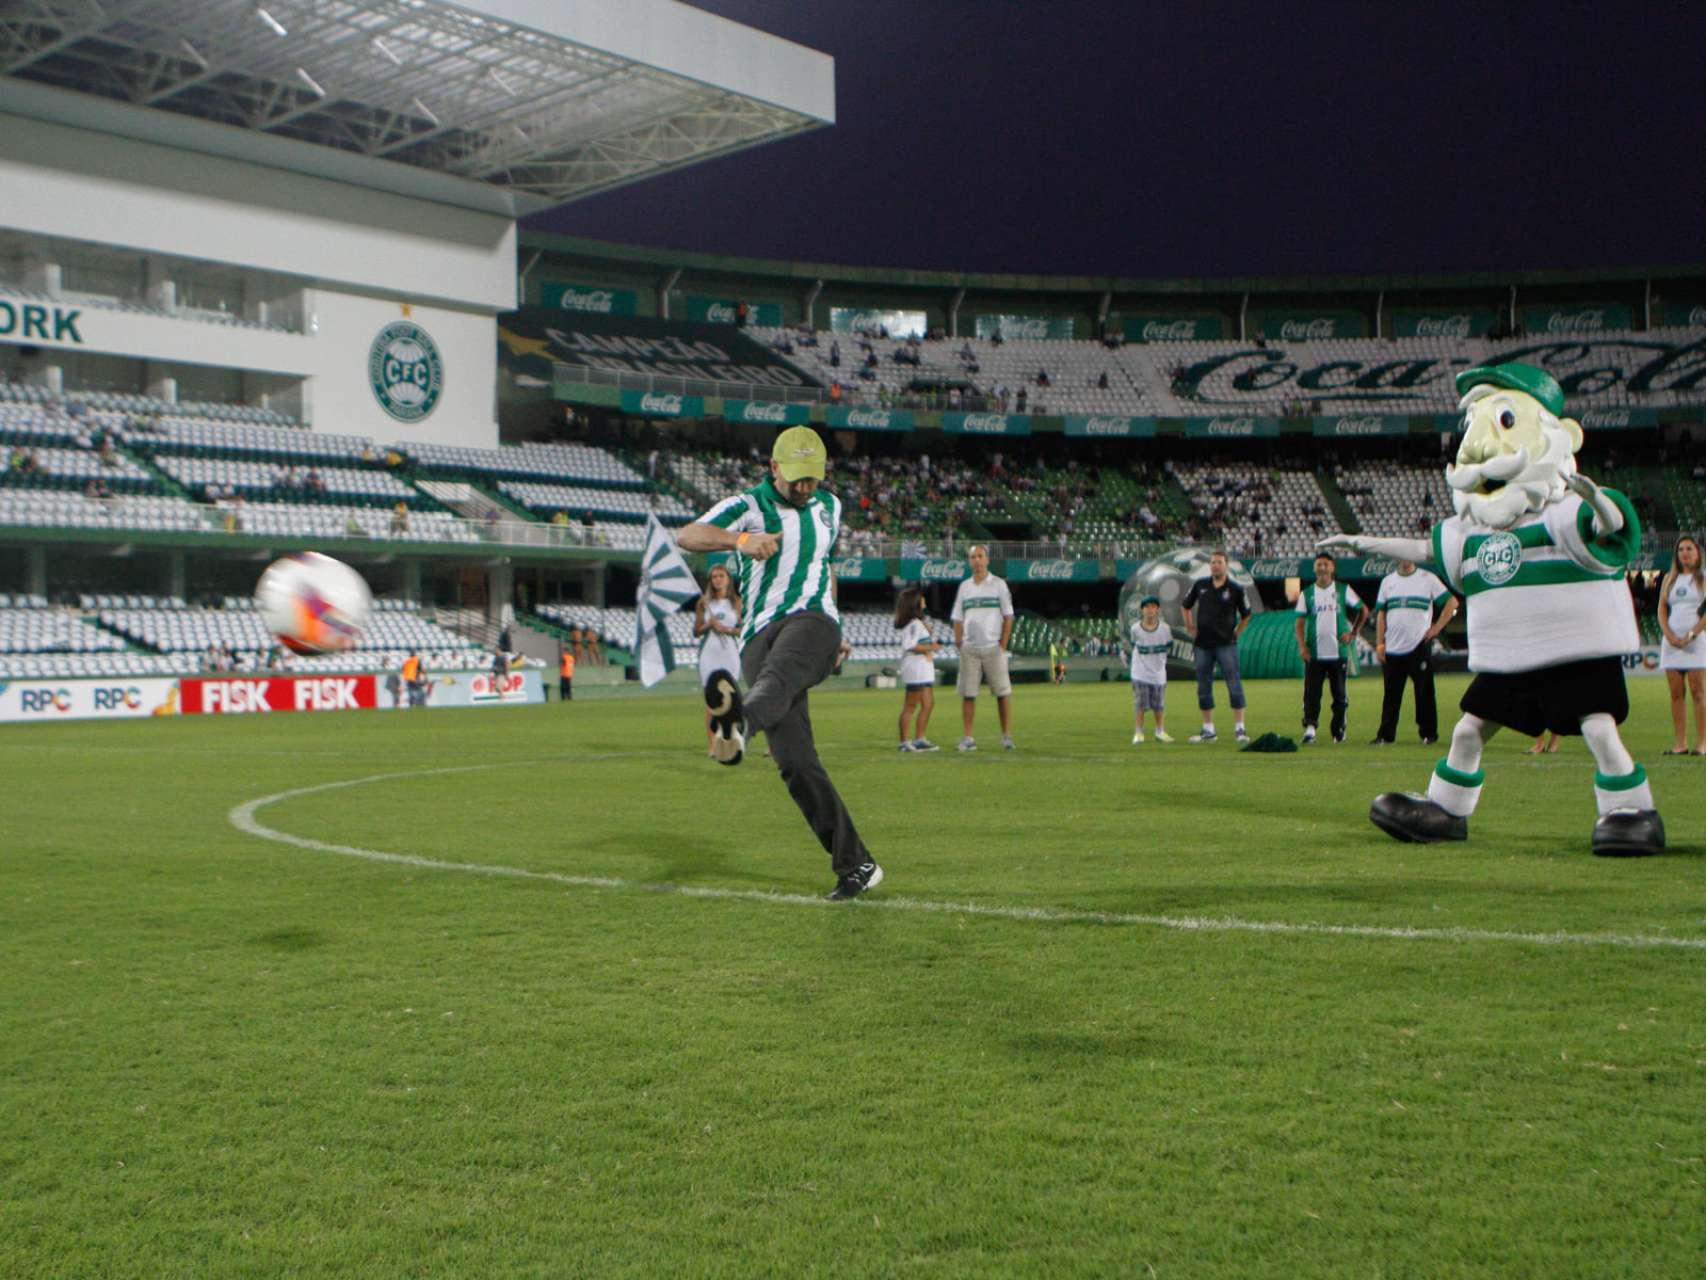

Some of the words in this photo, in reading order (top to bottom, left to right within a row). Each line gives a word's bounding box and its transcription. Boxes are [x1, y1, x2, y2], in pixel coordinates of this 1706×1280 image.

[386, 358, 428, 387] CFC
[21, 687, 71, 712] RPC
[94, 686, 142, 710] RPC
[202, 680, 272, 714] FISK
[293, 678, 360, 711] FISK
